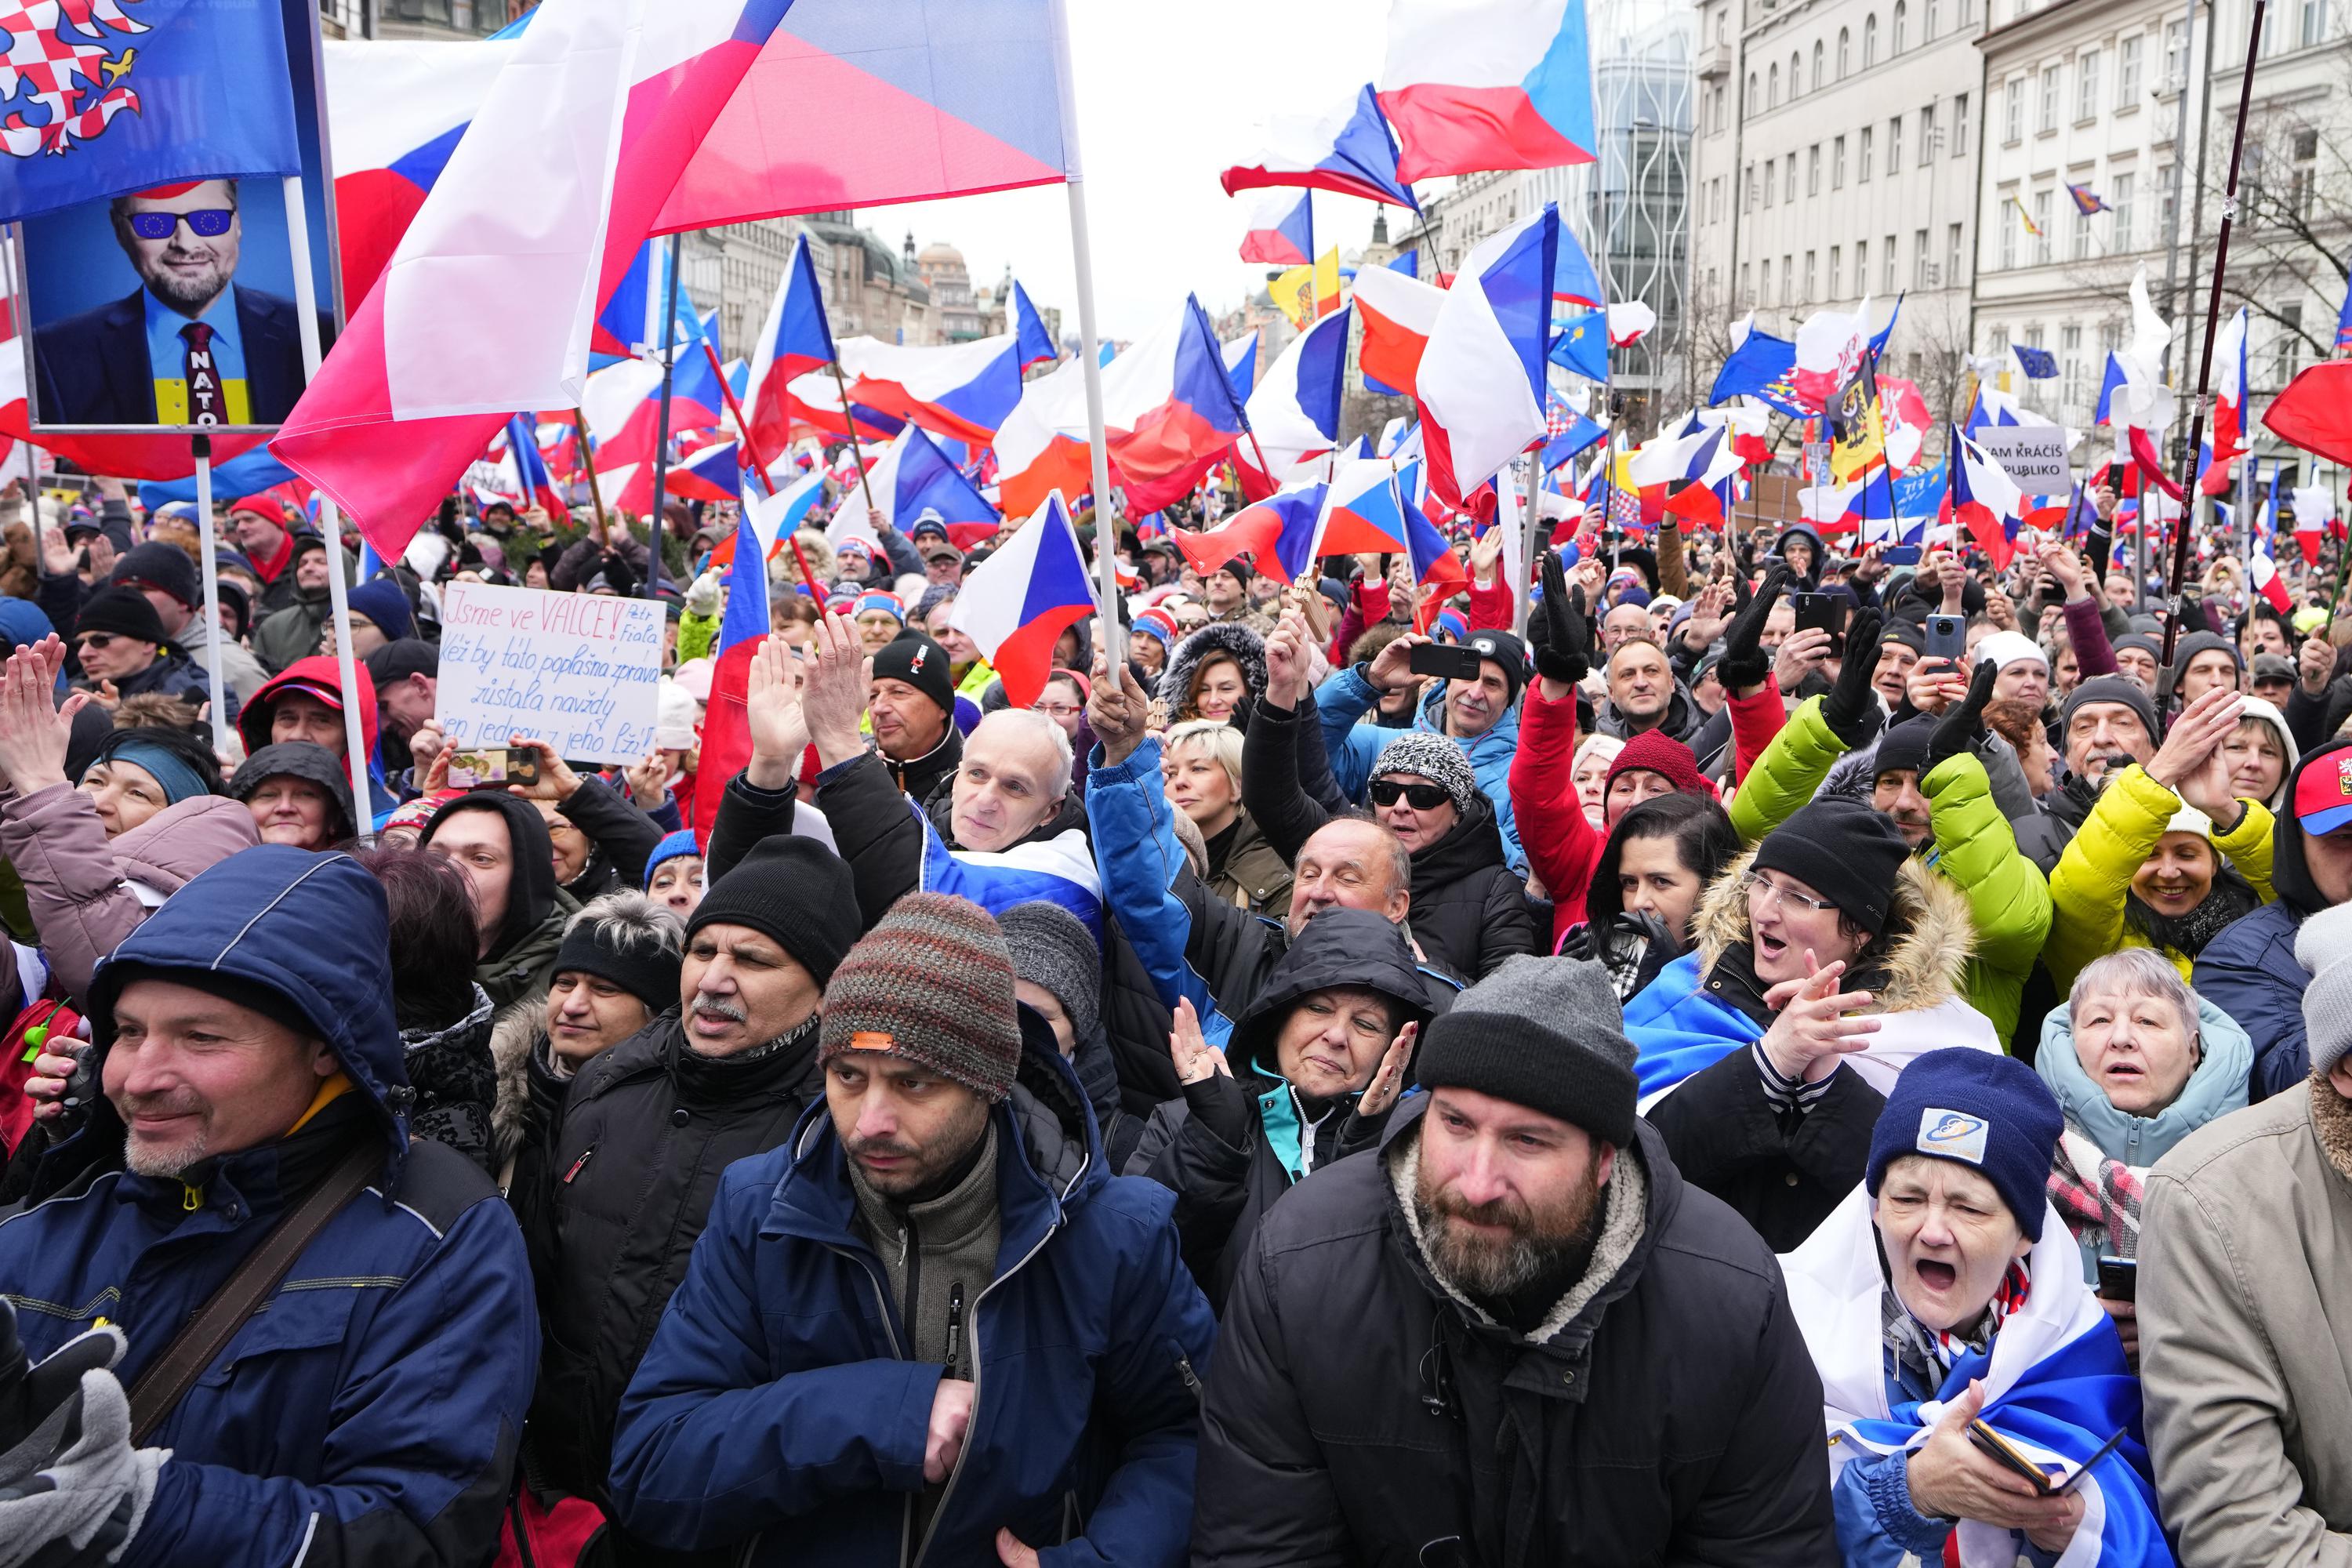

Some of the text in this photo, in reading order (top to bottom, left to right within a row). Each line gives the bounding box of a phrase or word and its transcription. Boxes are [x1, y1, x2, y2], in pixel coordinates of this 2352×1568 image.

[191, 351, 217, 426] NATO
[1985, 444, 2063, 458] AM KRÁČÍŠ
[446, 590, 626, 640] Jsme ve VÁLCE!
[626, 604, 652, 620] Petr
[470, 634, 495, 673] by
[619, 624, 658, 644] Fiala
[470, 678, 616, 731] zůstala navždy
[444, 710, 468, 738] jen
[560, 722, 604, 758] jeho
